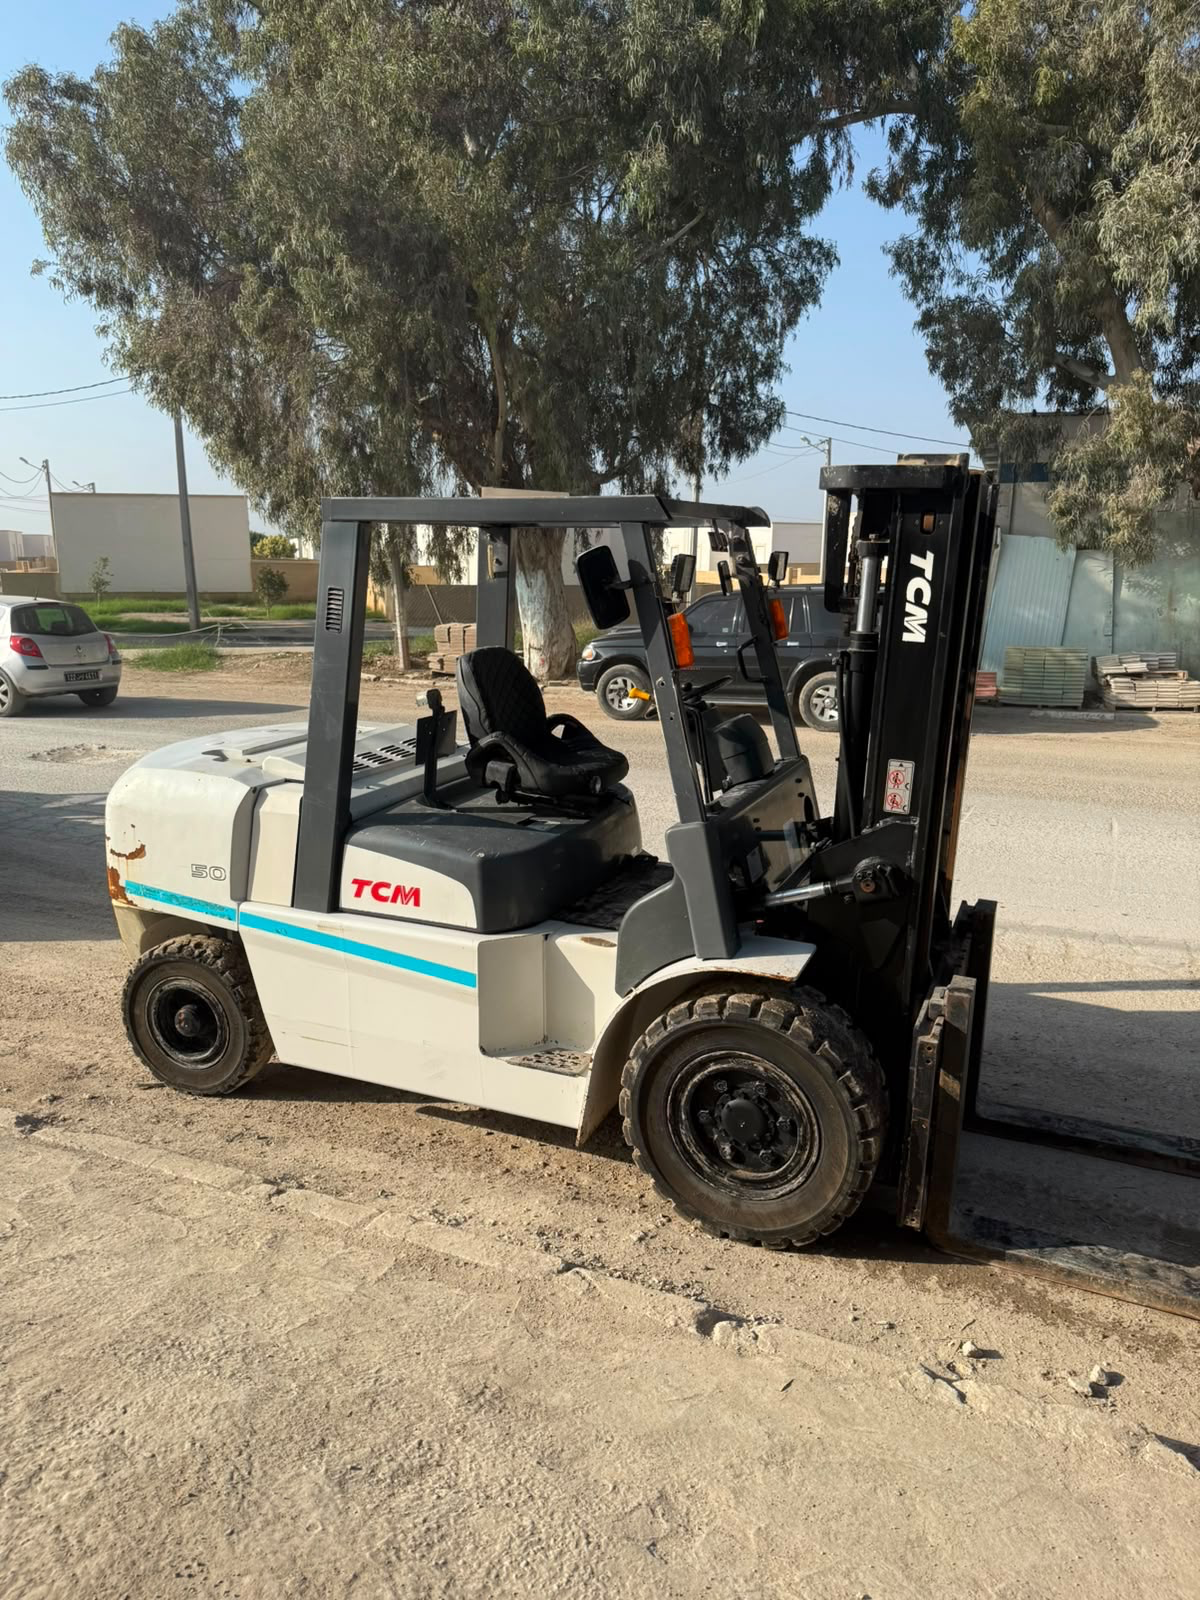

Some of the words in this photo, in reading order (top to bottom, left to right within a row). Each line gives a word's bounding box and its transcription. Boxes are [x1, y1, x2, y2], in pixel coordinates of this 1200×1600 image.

[901, 550, 935, 643] TCM
[190, 863, 227, 882] 50
[351, 878, 421, 908] TCM
